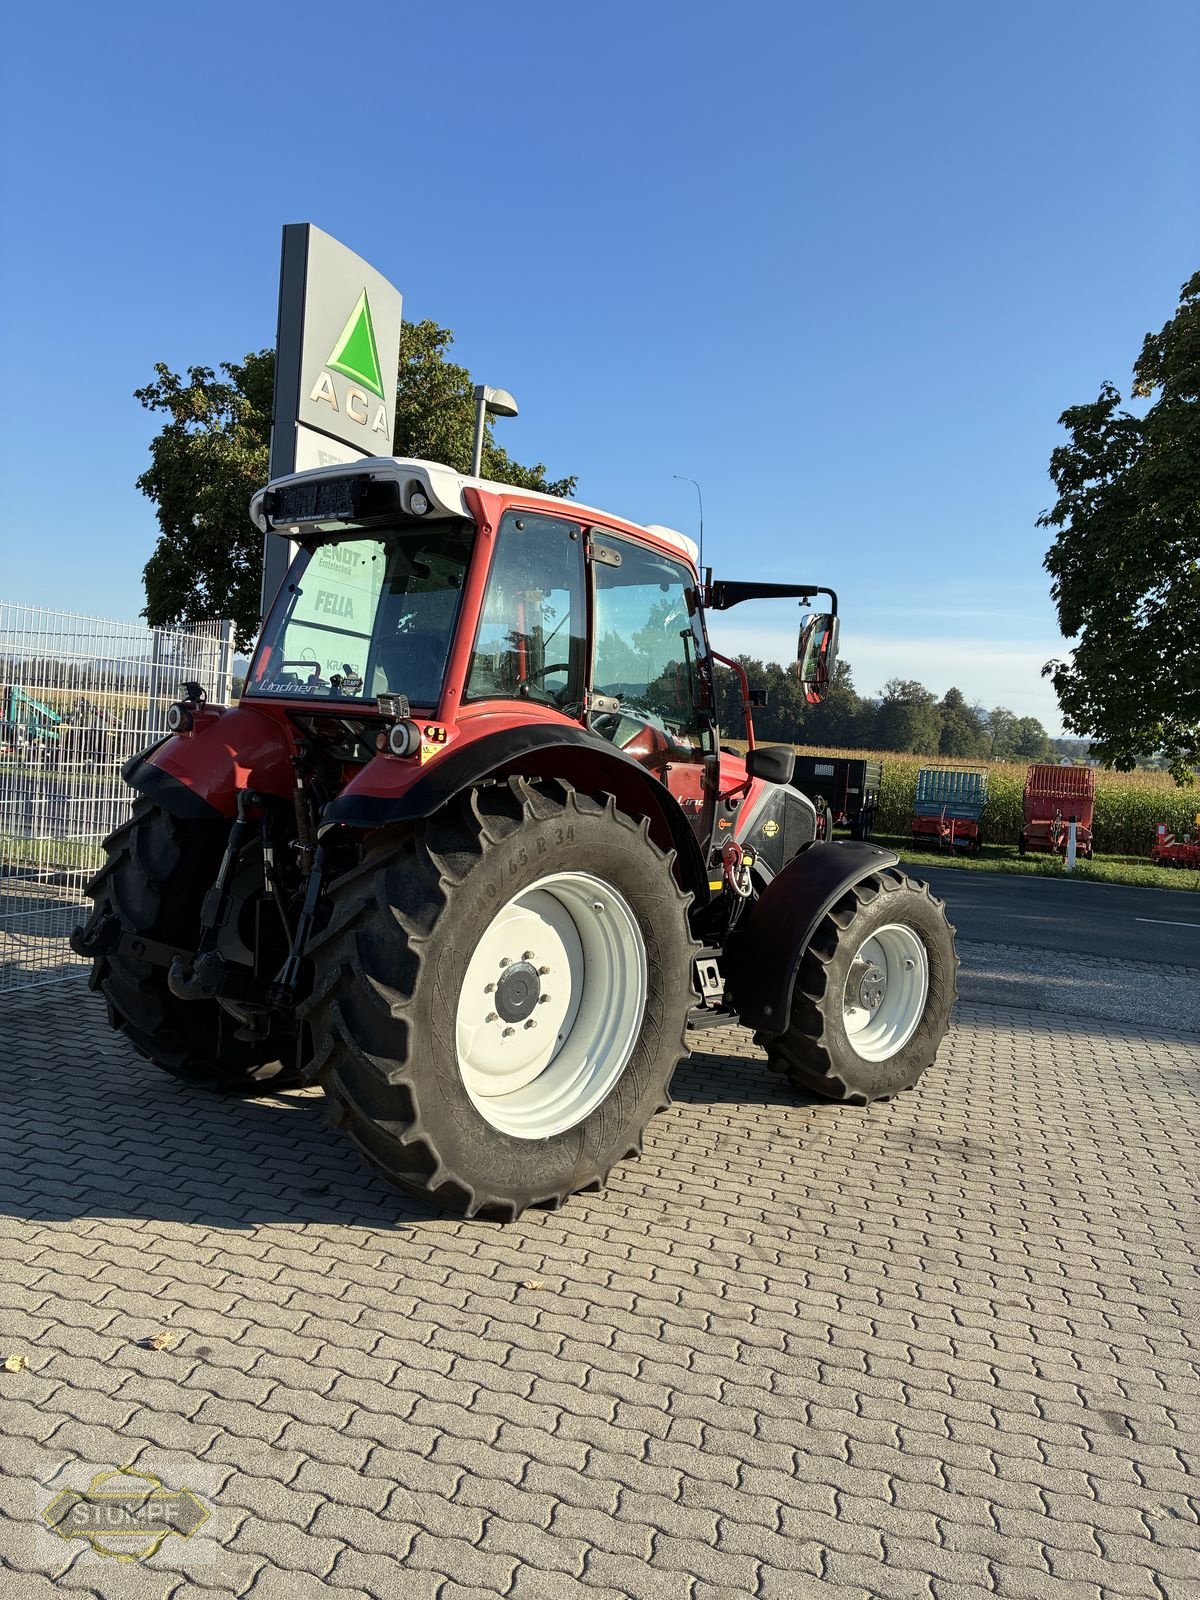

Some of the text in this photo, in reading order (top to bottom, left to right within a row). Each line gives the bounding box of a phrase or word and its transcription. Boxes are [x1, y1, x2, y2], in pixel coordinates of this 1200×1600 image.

[309, 371, 390, 441] ACA
[314, 589, 354, 620] FELLA
[259, 680, 318, 693] Lindner
[554, 825, 576, 846] 34
